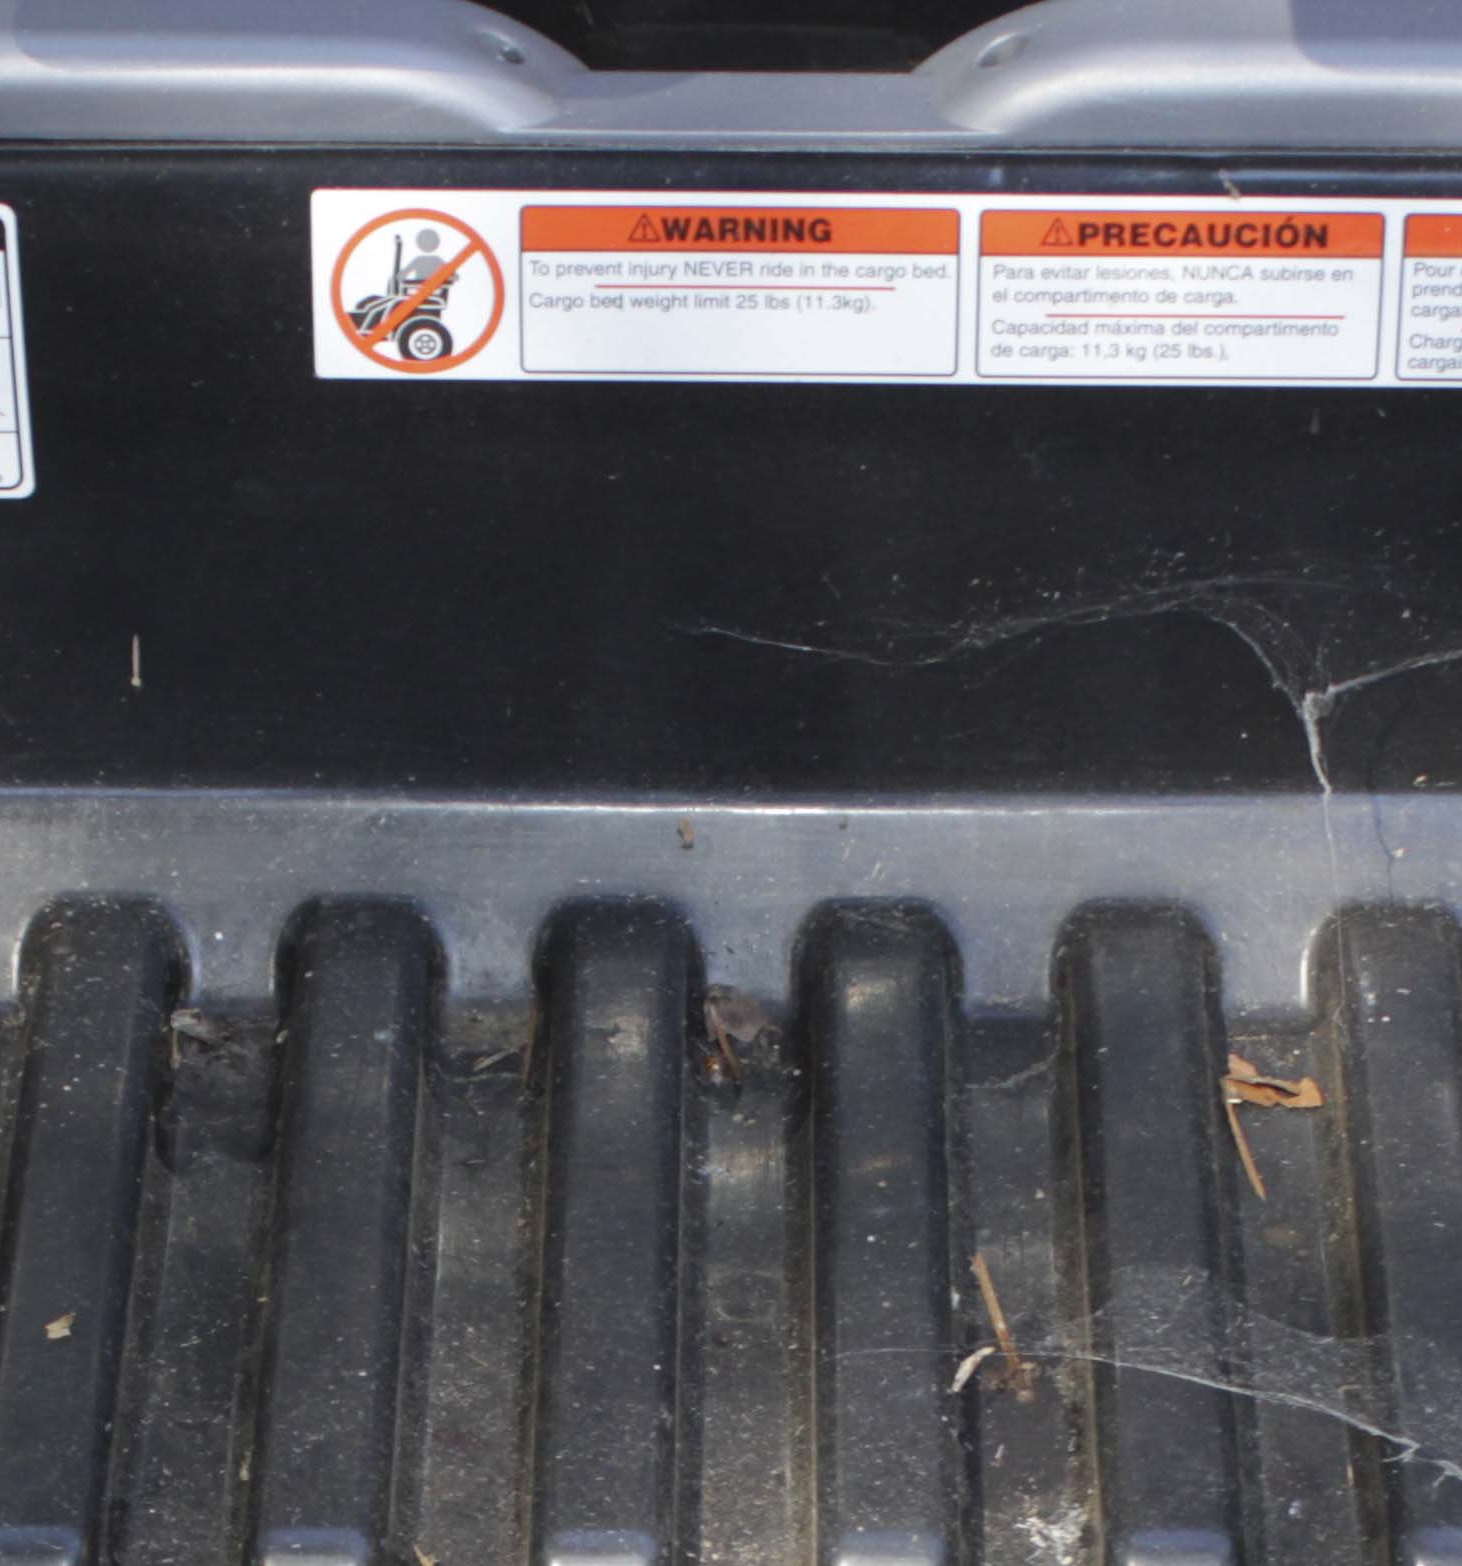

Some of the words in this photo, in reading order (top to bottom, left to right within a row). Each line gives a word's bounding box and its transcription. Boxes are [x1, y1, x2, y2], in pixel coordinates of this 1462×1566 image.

[660, 217, 832, 243] WARNING
[1078, 217, 1328, 248] PRECAUCIÓN
[530, 260, 550, 276] To
[556, 262, 622, 279] prevent
[629, 264, 677, 280] injury
[684, 261, 753, 278] NEVER
[760, 263, 794, 277] ride
[800, 265, 815, 276] in
[821, 263, 850, 277] the
[855, 266, 906, 282] cargo
[912, 264, 949, 279] bed.
[993, 264, 1035, 280] Para
[1041, 267, 1090, 280] evitar
[1183, 264, 1254, 280] NUNCA
[1260, 267, 1325, 281] subirse
[1330, 270, 1354, 282] en
[1413, 262, 1455, 278] Pour
[529, 293, 584, 312] Cargo
[590, 294, 623, 309] bed
[630, 294, 688, 312] weight
[694, 295, 730, 308] limit
[736, 294, 758, 309] 25
[765, 295, 790, 309] lbs
[992, 288, 1008, 303] el
[1014, 290, 1149, 305] compartimento
[1156, 290, 1177, 303] de
[1184, 292, 1237, 308] carga.
[992, 319, 1089, 337] Capacidad
[1095, 320, 1165, 335] máxima
[1171, 320, 1198, 335] del
[1204, 322, 1339, 338] compartimento
[990, 343, 1013, 357] de
[1126, 344, 1147, 362] kg
[1153, 344, 1182, 360] (25
